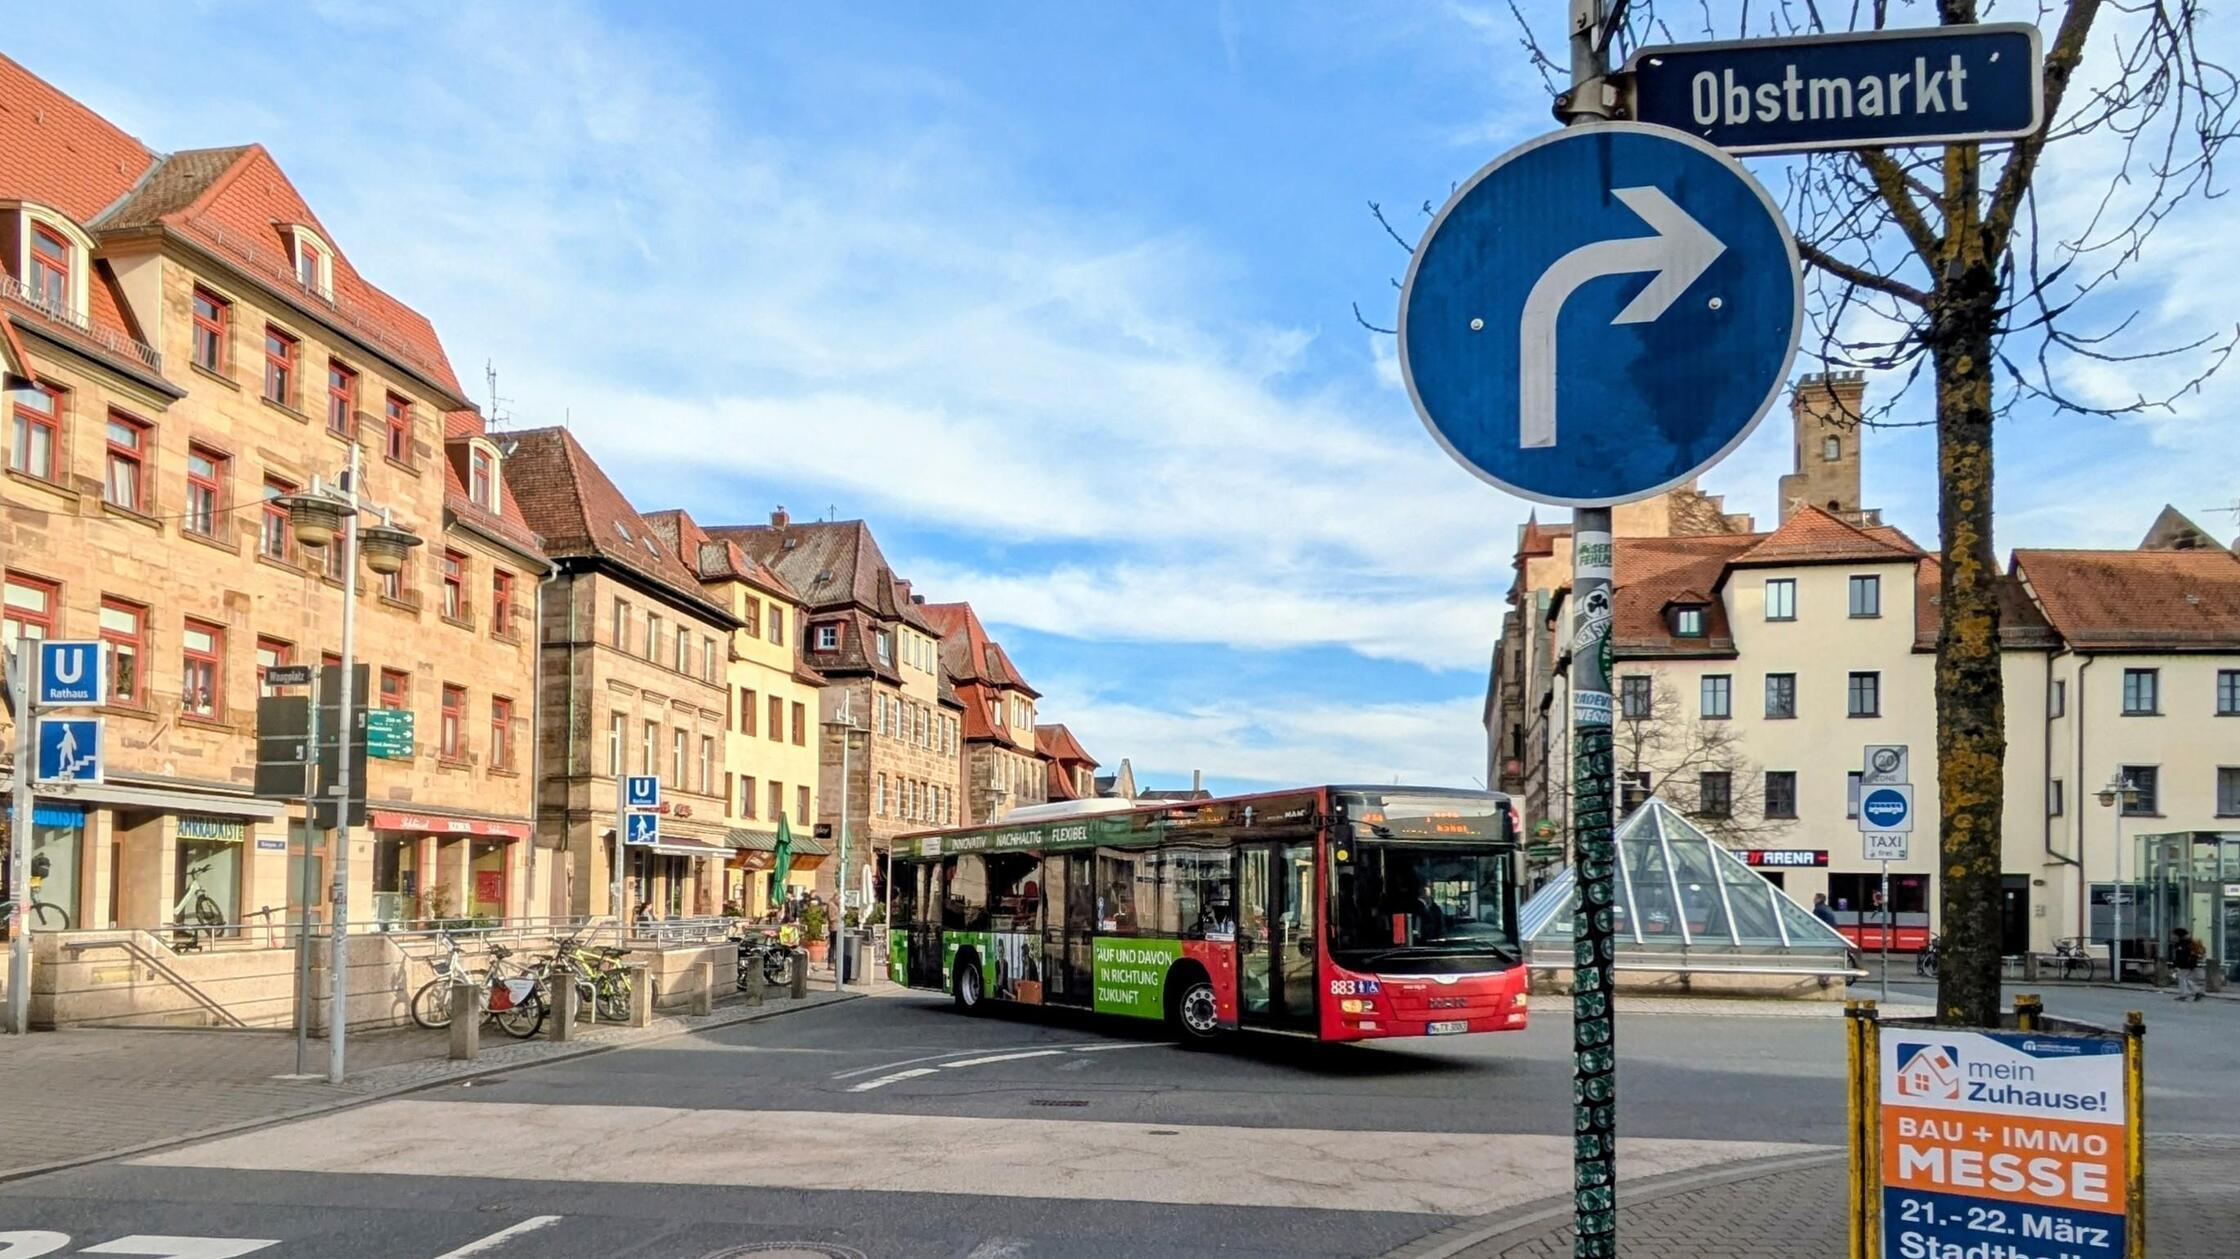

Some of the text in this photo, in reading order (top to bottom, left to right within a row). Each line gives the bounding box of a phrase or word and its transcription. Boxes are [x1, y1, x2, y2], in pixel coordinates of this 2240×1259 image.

[1692, 55, 1968, 125] Obstmarkt
[55, 648, 83, 684] U
[50, 688, 89, 699] Rathaus
[635, 779, 649, 797] U
[177, 816, 244, 840] AHRRADKISTE
[952, 835, 987, 850] INNOVATIV
[996, 830, 1041, 847] NACHHALTIG
[1051, 826, 1087, 842] FLEXIBEL
[1869, 835, 1901, 848] TAXI
[1763, 852, 1814, 865] ARENA
[1115, 949, 1136, 964] UND
[1101, 968, 1158, 986] IN RICHTUNG
[1330, 980, 1356, 995] 883
[1098, 987, 1139, 1005] ZUKUNFT
[1969, 1060, 2034, 1081] mein
[1968, 1081, 2107, 1112] Zuhause!
[1899, 1117, 2107, 1156] BAU + IMMO
[1899, 1143, 2109, 1203] MESSE
[2022, 1213, 2110, 1247] März
